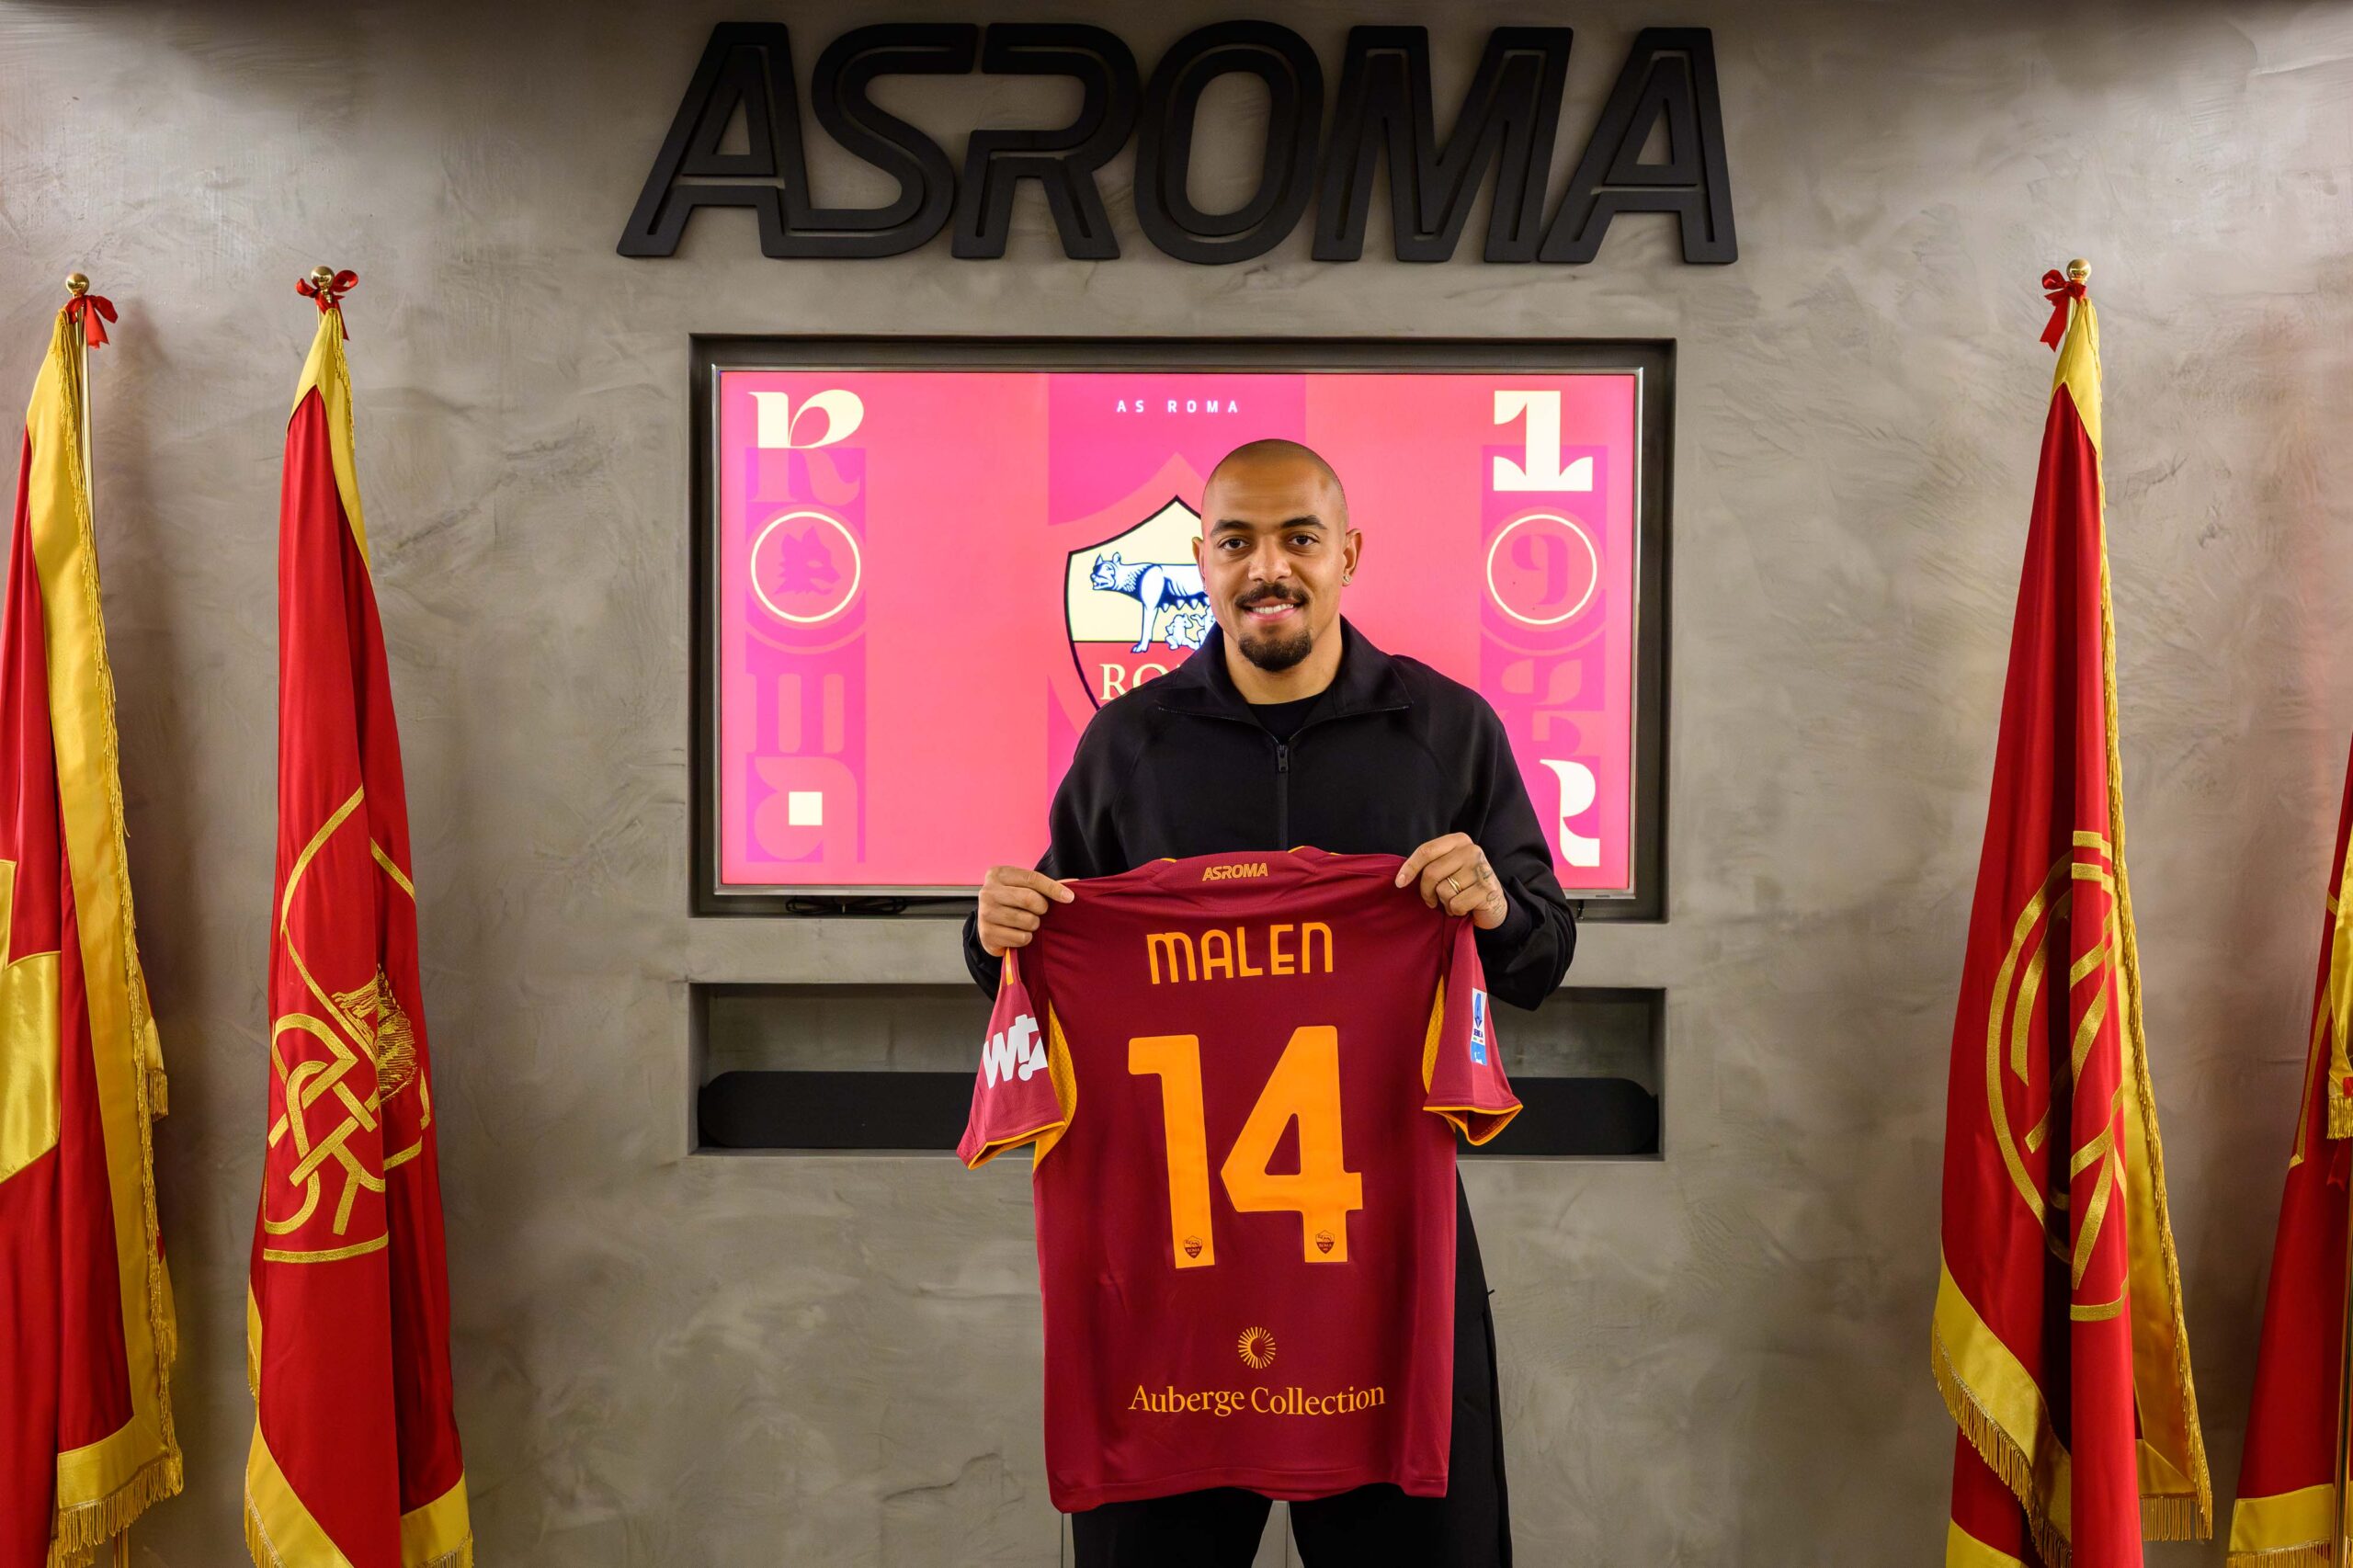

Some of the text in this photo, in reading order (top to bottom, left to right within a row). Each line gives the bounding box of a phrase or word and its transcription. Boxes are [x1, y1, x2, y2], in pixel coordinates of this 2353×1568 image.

[1117, 400, 1238, 413] AS ROMA
[1202, 862, 1268, 881] ASROMA
[1128, 1025, 1363, 1269] 14
[1128, 1384, 1386, 1417] Auberge Collection
